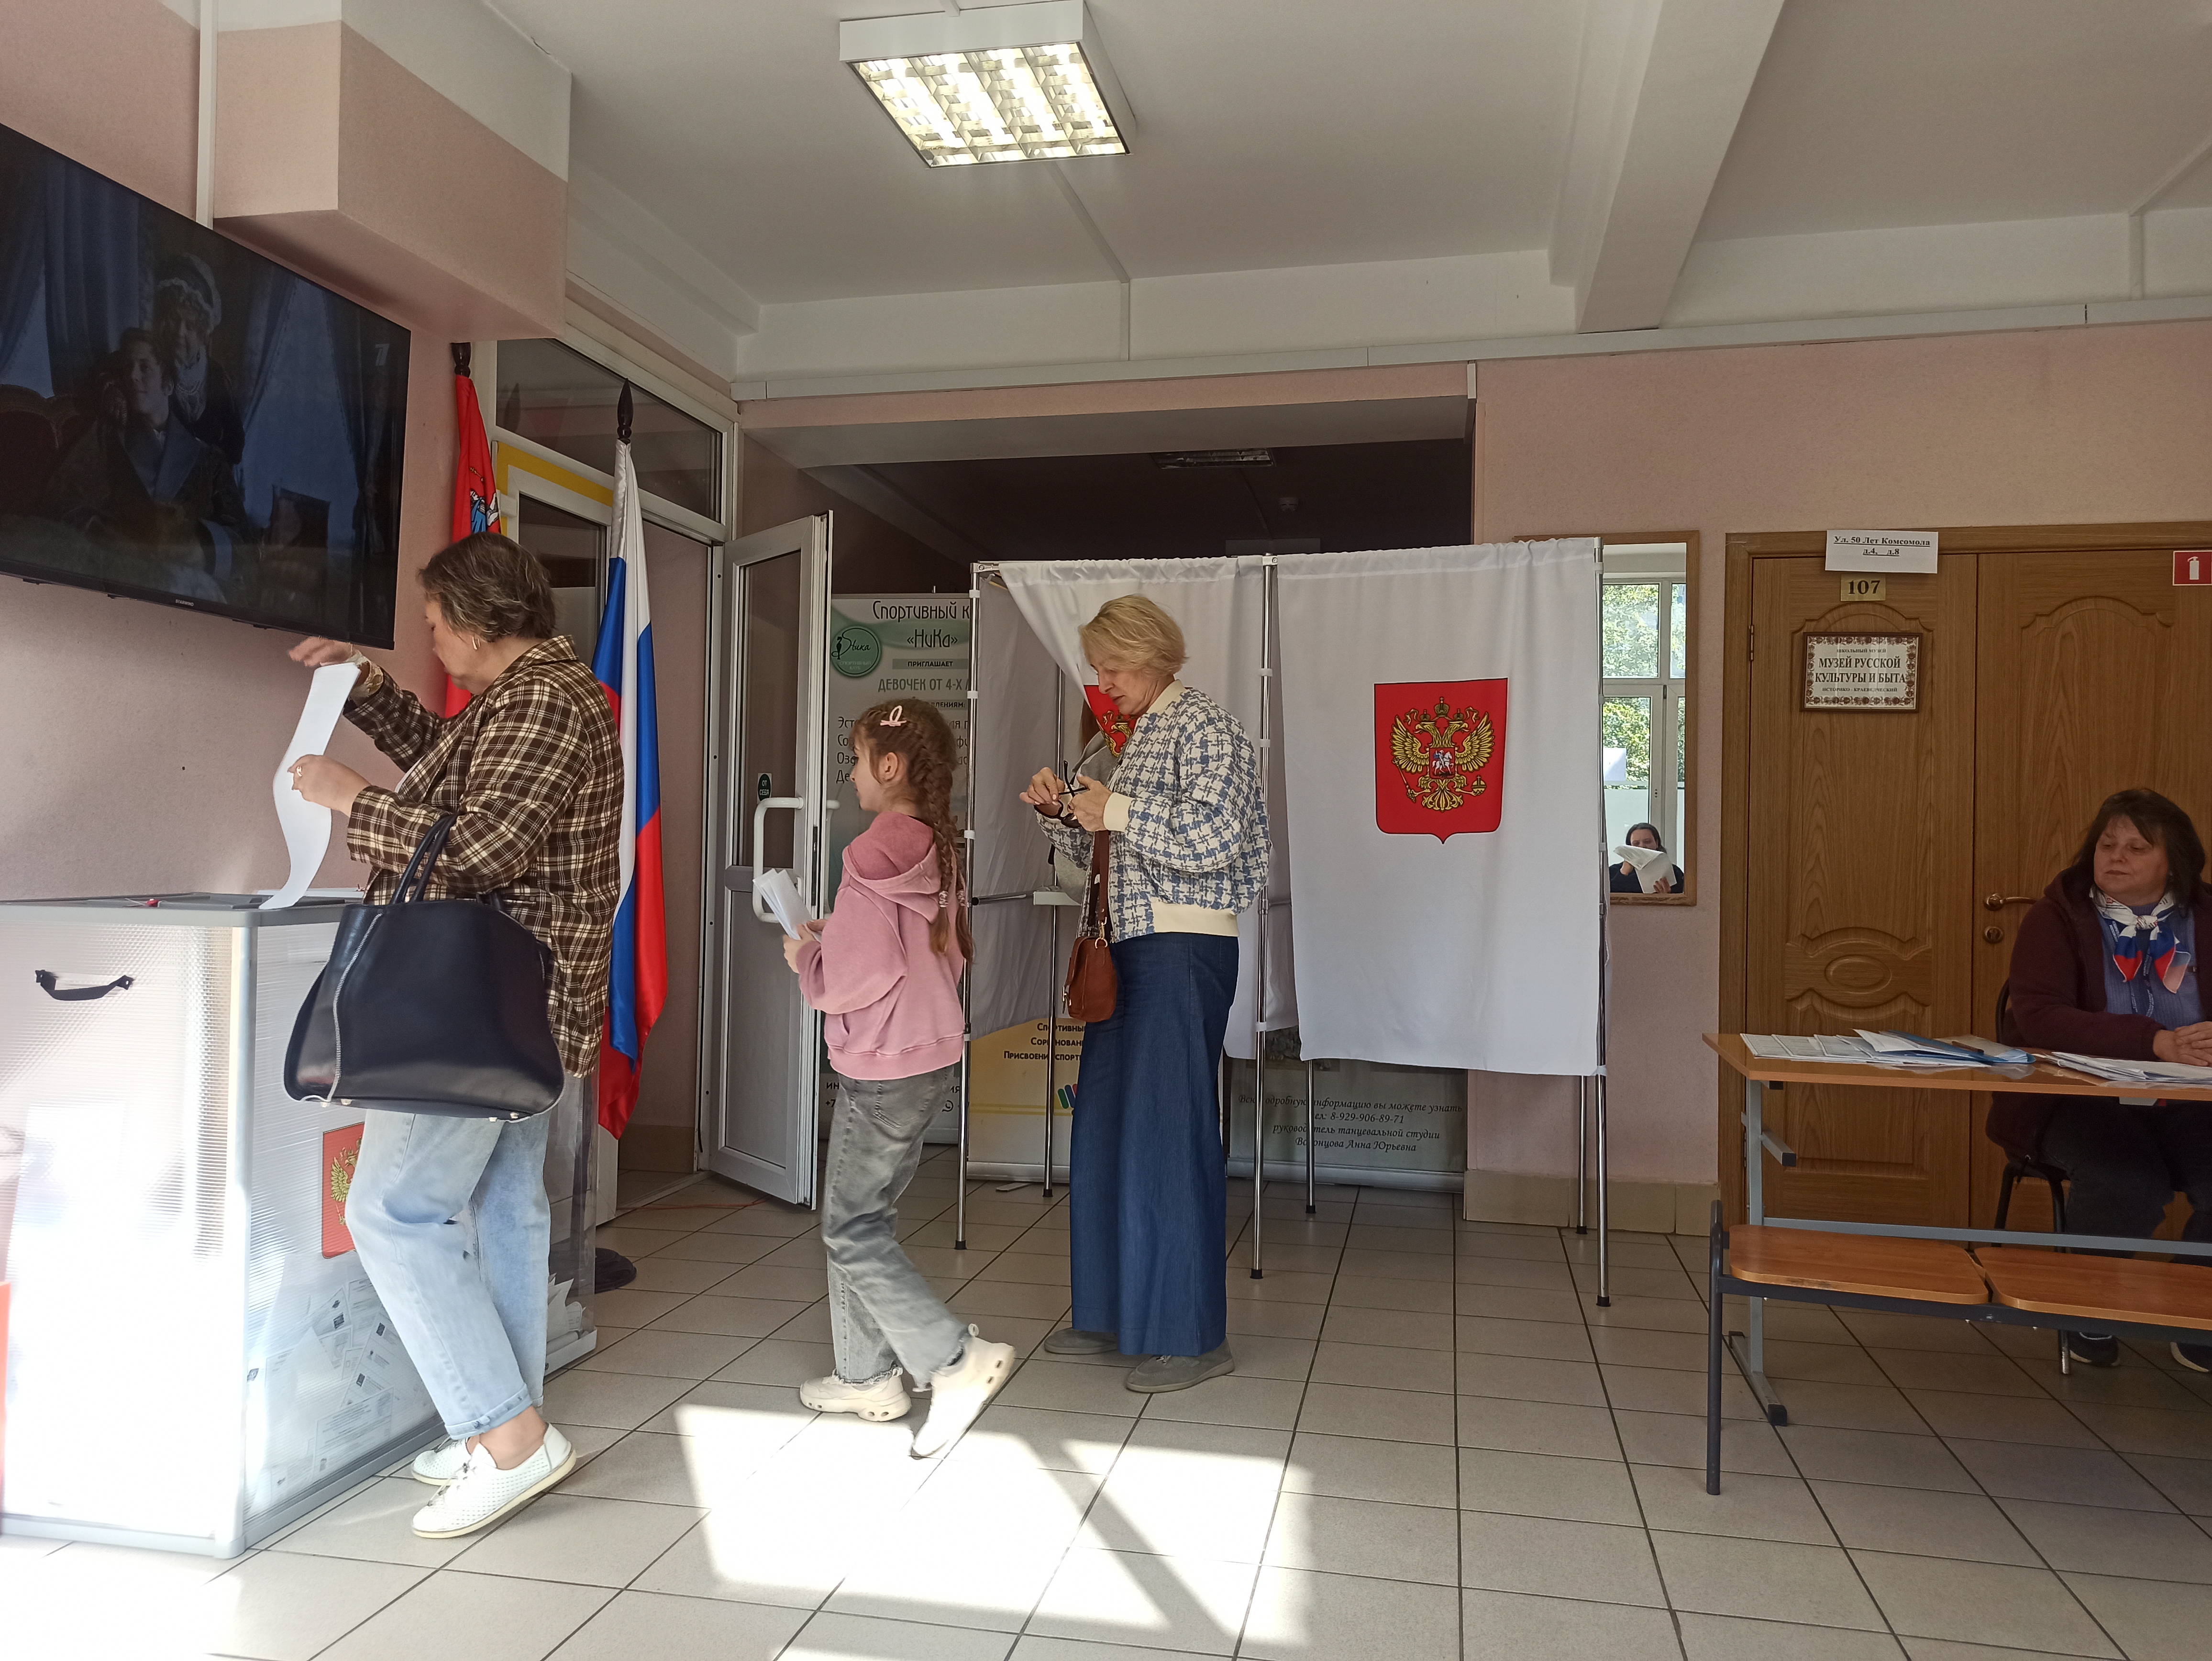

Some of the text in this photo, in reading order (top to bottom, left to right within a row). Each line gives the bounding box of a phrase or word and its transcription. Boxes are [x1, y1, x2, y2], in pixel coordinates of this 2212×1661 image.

[1881, 537, 1930, 545] Комсомола
[1848, 580, 1880, 595] 107
[873, 601, 957, 622] Спортивный
[1819, 655, 1901, 668] МУЗЕЙ РУССКОЙ
[1815, 673, 1906, 683] КУЛЬТУРЫ И БЫТА
[878, 678, 926, 692] ДЕВОЧЕК
[929, 678, 942, 690] ОТ
[946, 678, 962, 690] 4-Х
[1388, 1103, 1427, 1112] можете
[1428, 1105, 1462, 1114] узнать
[1330, 1112, 1404, 1123] 8-929-906-89-71
[1338, 1127, 1403, 1138] танцевальной
[1406, 1129, 1440, 1141] студии
[1346, 1140, 1371, 1149] Анна
[1373, 1141, 1416, 1152] Юрьевна
